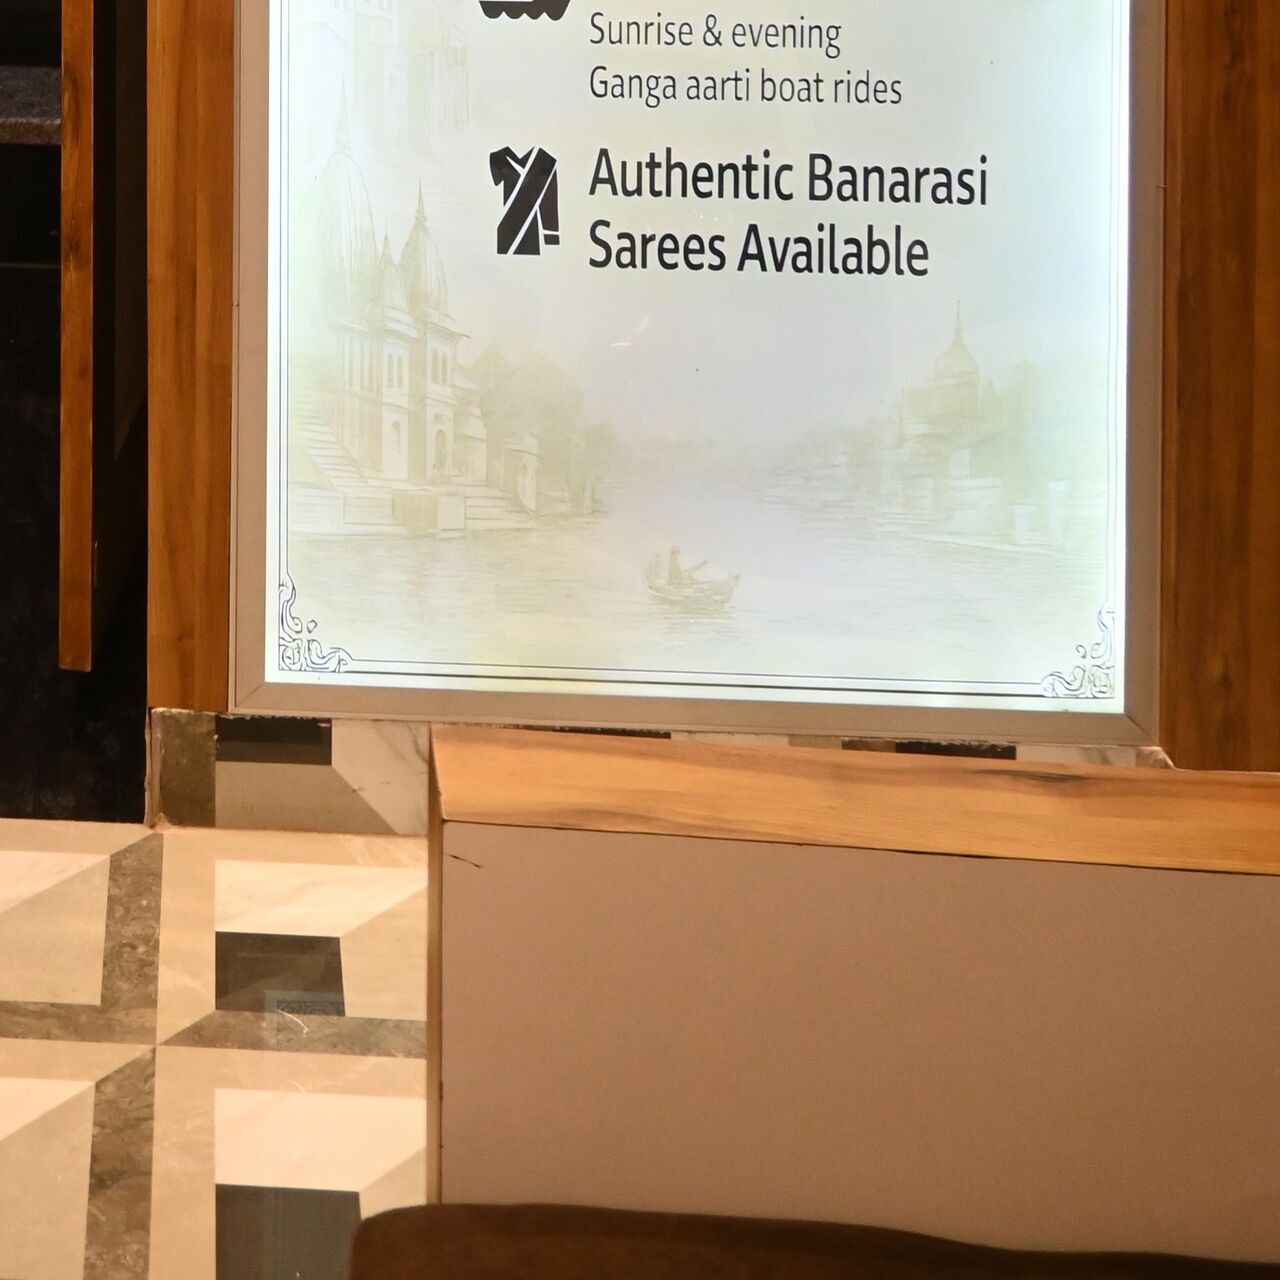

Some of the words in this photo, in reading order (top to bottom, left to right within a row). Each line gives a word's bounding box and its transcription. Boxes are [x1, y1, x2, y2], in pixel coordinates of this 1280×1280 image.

[590, 12, 693, 46] Sunrise
[703, 14, 722, 46] &
[732, 16, 842, 59] evening
[590, 66, 677, 108] Ganga
[687, 68, 750, 101] aarti
[761, 68, 824, 102] boat
[834, 70, 901, 104] rides
[589, 147, 793, 201] Authentic
[809, 153, 987, 205] Banarasi
[589, 219, 726, 271] Sarees
[737, 223, 929, 276] Available
